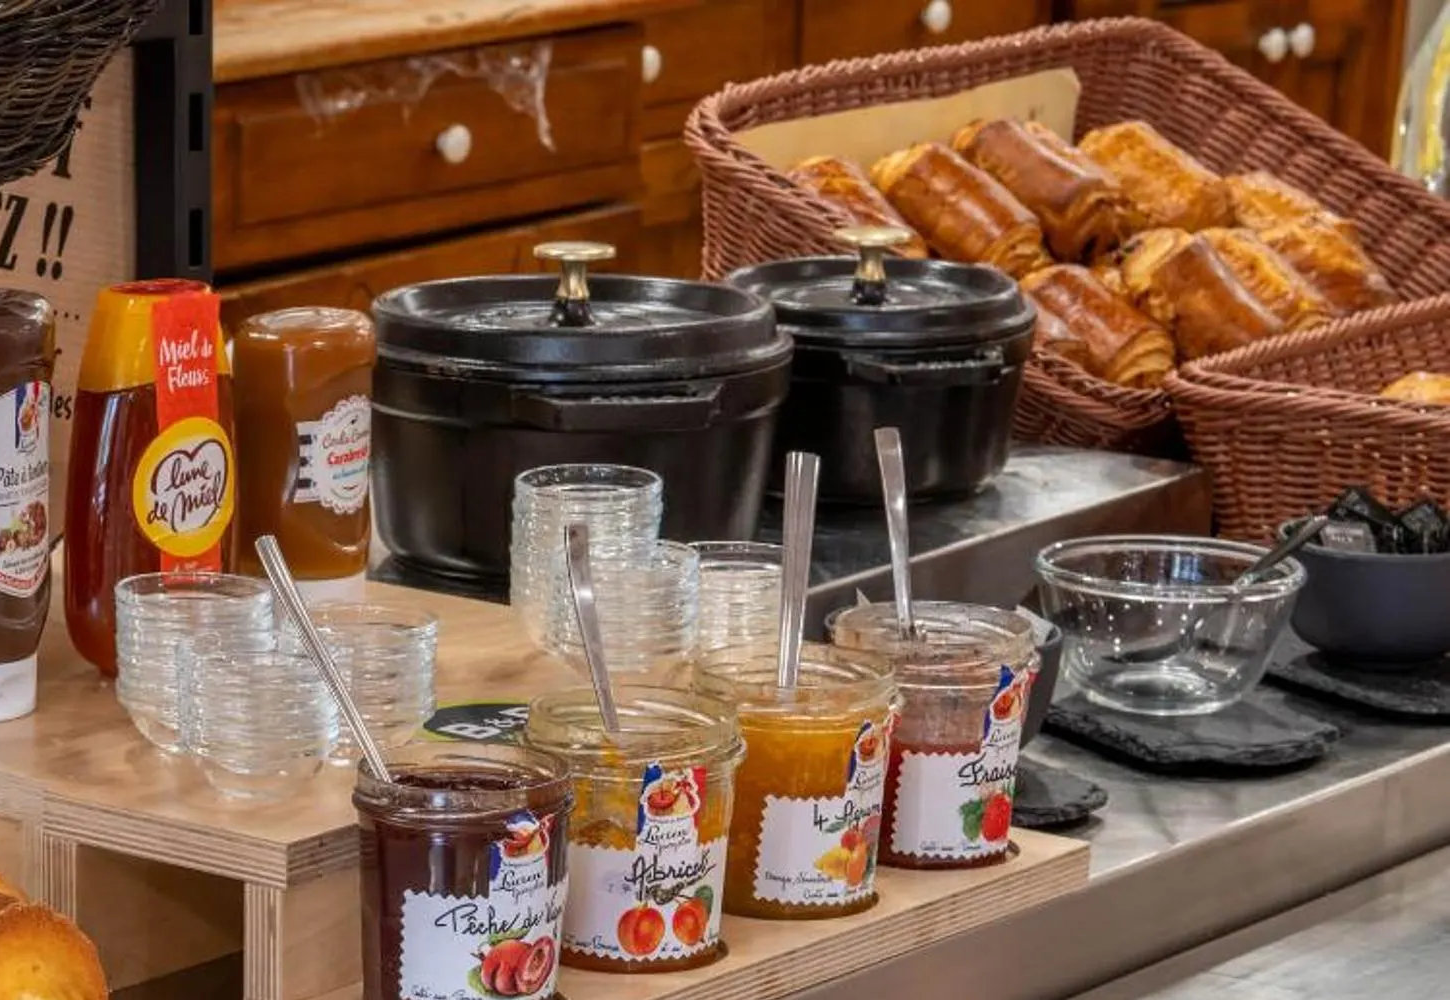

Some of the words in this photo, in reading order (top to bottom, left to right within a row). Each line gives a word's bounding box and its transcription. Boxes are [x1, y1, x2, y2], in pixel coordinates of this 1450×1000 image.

[36, 202, 74, 280] !!
[158, 329, 199, 367] Miel
[167, 362, 213, 394] Fleurs
[164, 457, 211, 493] lune
[146, 499, 169, 525] de
[623, 848, 717, 905] Abricot
[434, 902, 521, 936] Pêche
